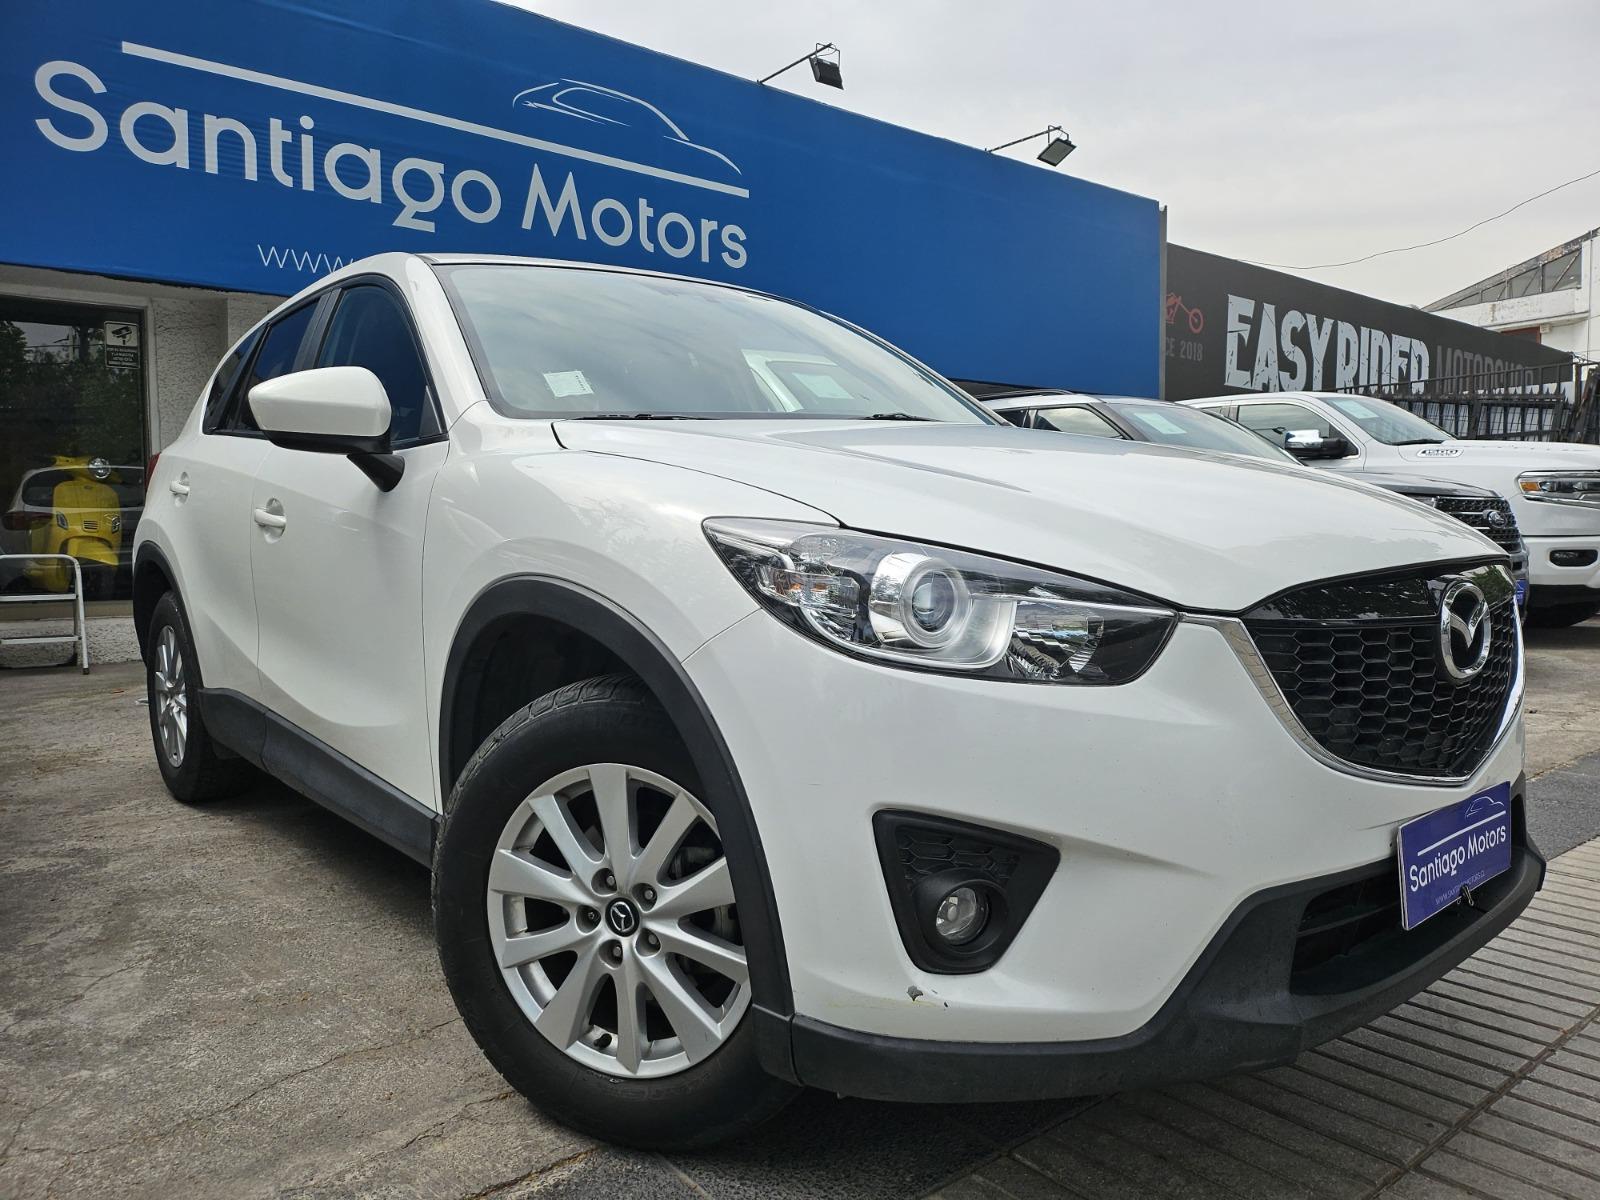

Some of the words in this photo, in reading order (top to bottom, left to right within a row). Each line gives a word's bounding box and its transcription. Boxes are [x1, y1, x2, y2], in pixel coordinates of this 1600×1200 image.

[34, 60, 502, 233] Santiago
[521, 163, 749, 269] Motors
[1180, 339, 1204, 362] 2018
[1409, 846, 1466, 892] Santiago
[1467, 825, 1506, 860] Motors
